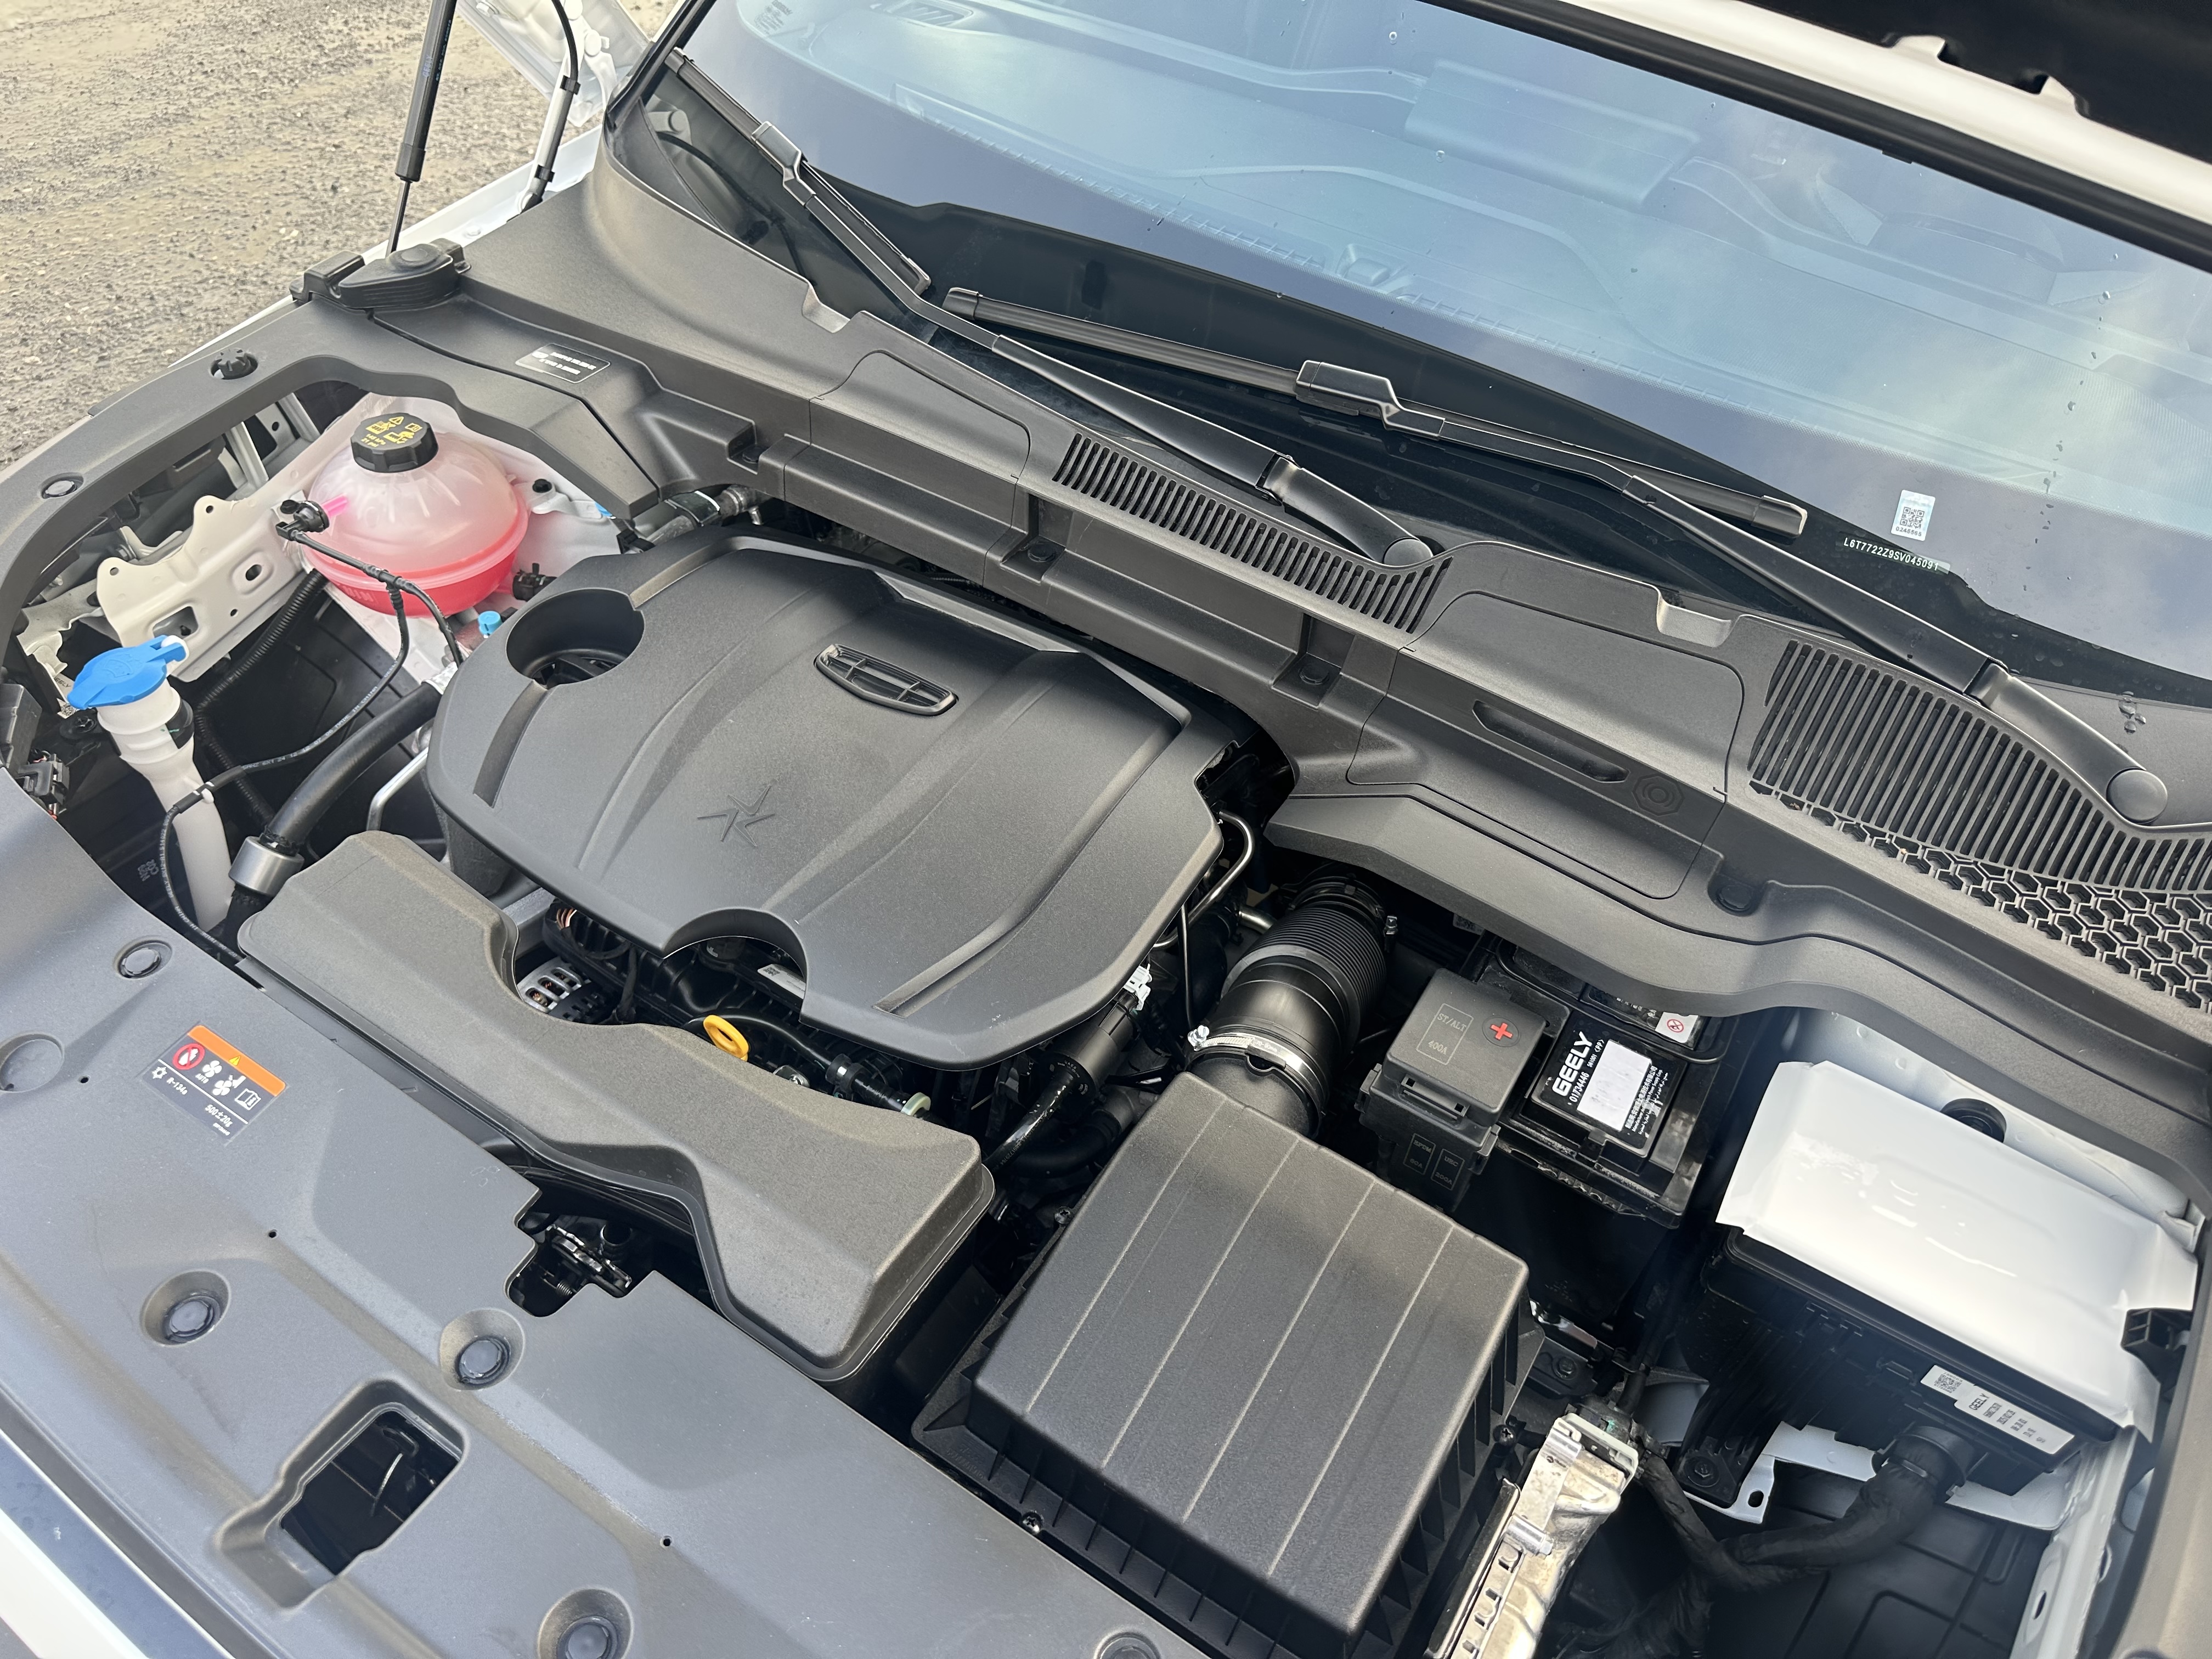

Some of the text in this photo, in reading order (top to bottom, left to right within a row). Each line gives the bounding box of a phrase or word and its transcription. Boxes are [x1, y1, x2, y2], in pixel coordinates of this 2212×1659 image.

[1895, 526, 1922, 537] 0245565
[1844, 537, 1939, 571] L6T7722Z9SV045091
[190, 922, 199, 930] IN
[1437, 1013, 1466, 1031] ST/ALT
[1428, 1040, 1448, 1055] 400A
[1551, 1031, 1593, 1097] GEELY
[167, 1077, 188, 1095] R-134a
[195, 1073, 208, 1084] AUTO
[205, 1104, 233, 1127] 500±20g
[1435, 1172, 1452, 1185] 200A
[1968, 1393, 1990, 1410] GEELY
